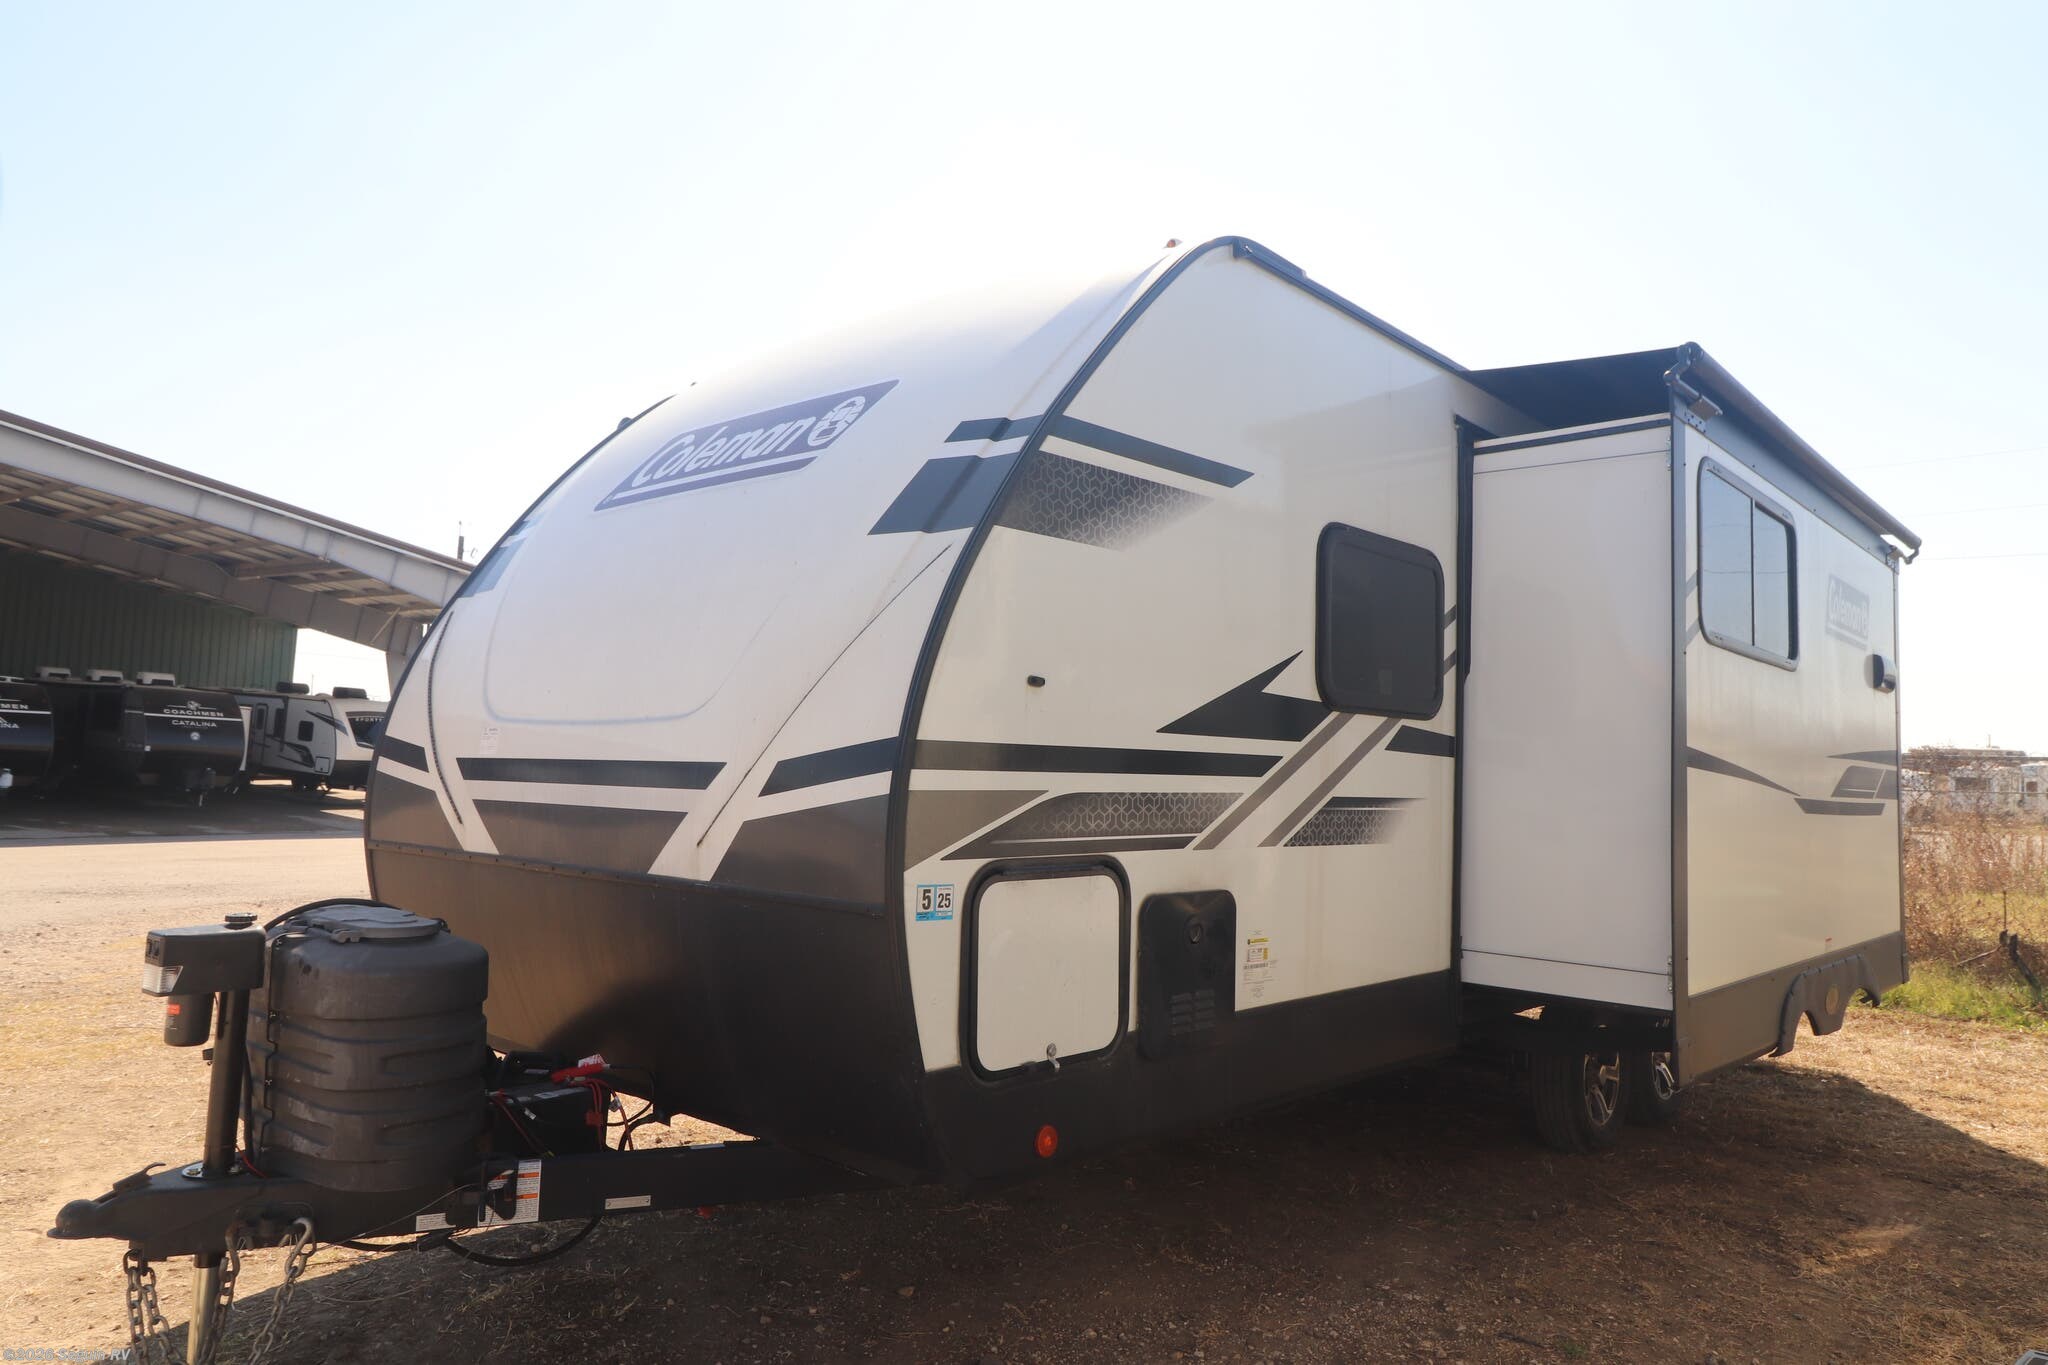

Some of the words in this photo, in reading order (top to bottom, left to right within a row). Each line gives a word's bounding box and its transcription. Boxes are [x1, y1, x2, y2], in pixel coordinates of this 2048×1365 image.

[632, 416, 817, 487] Coleman
[163, 708, 224, 717] COACHMEN
[922, 889, 931, 910] 5
[937, 893, 951, 908] 25
